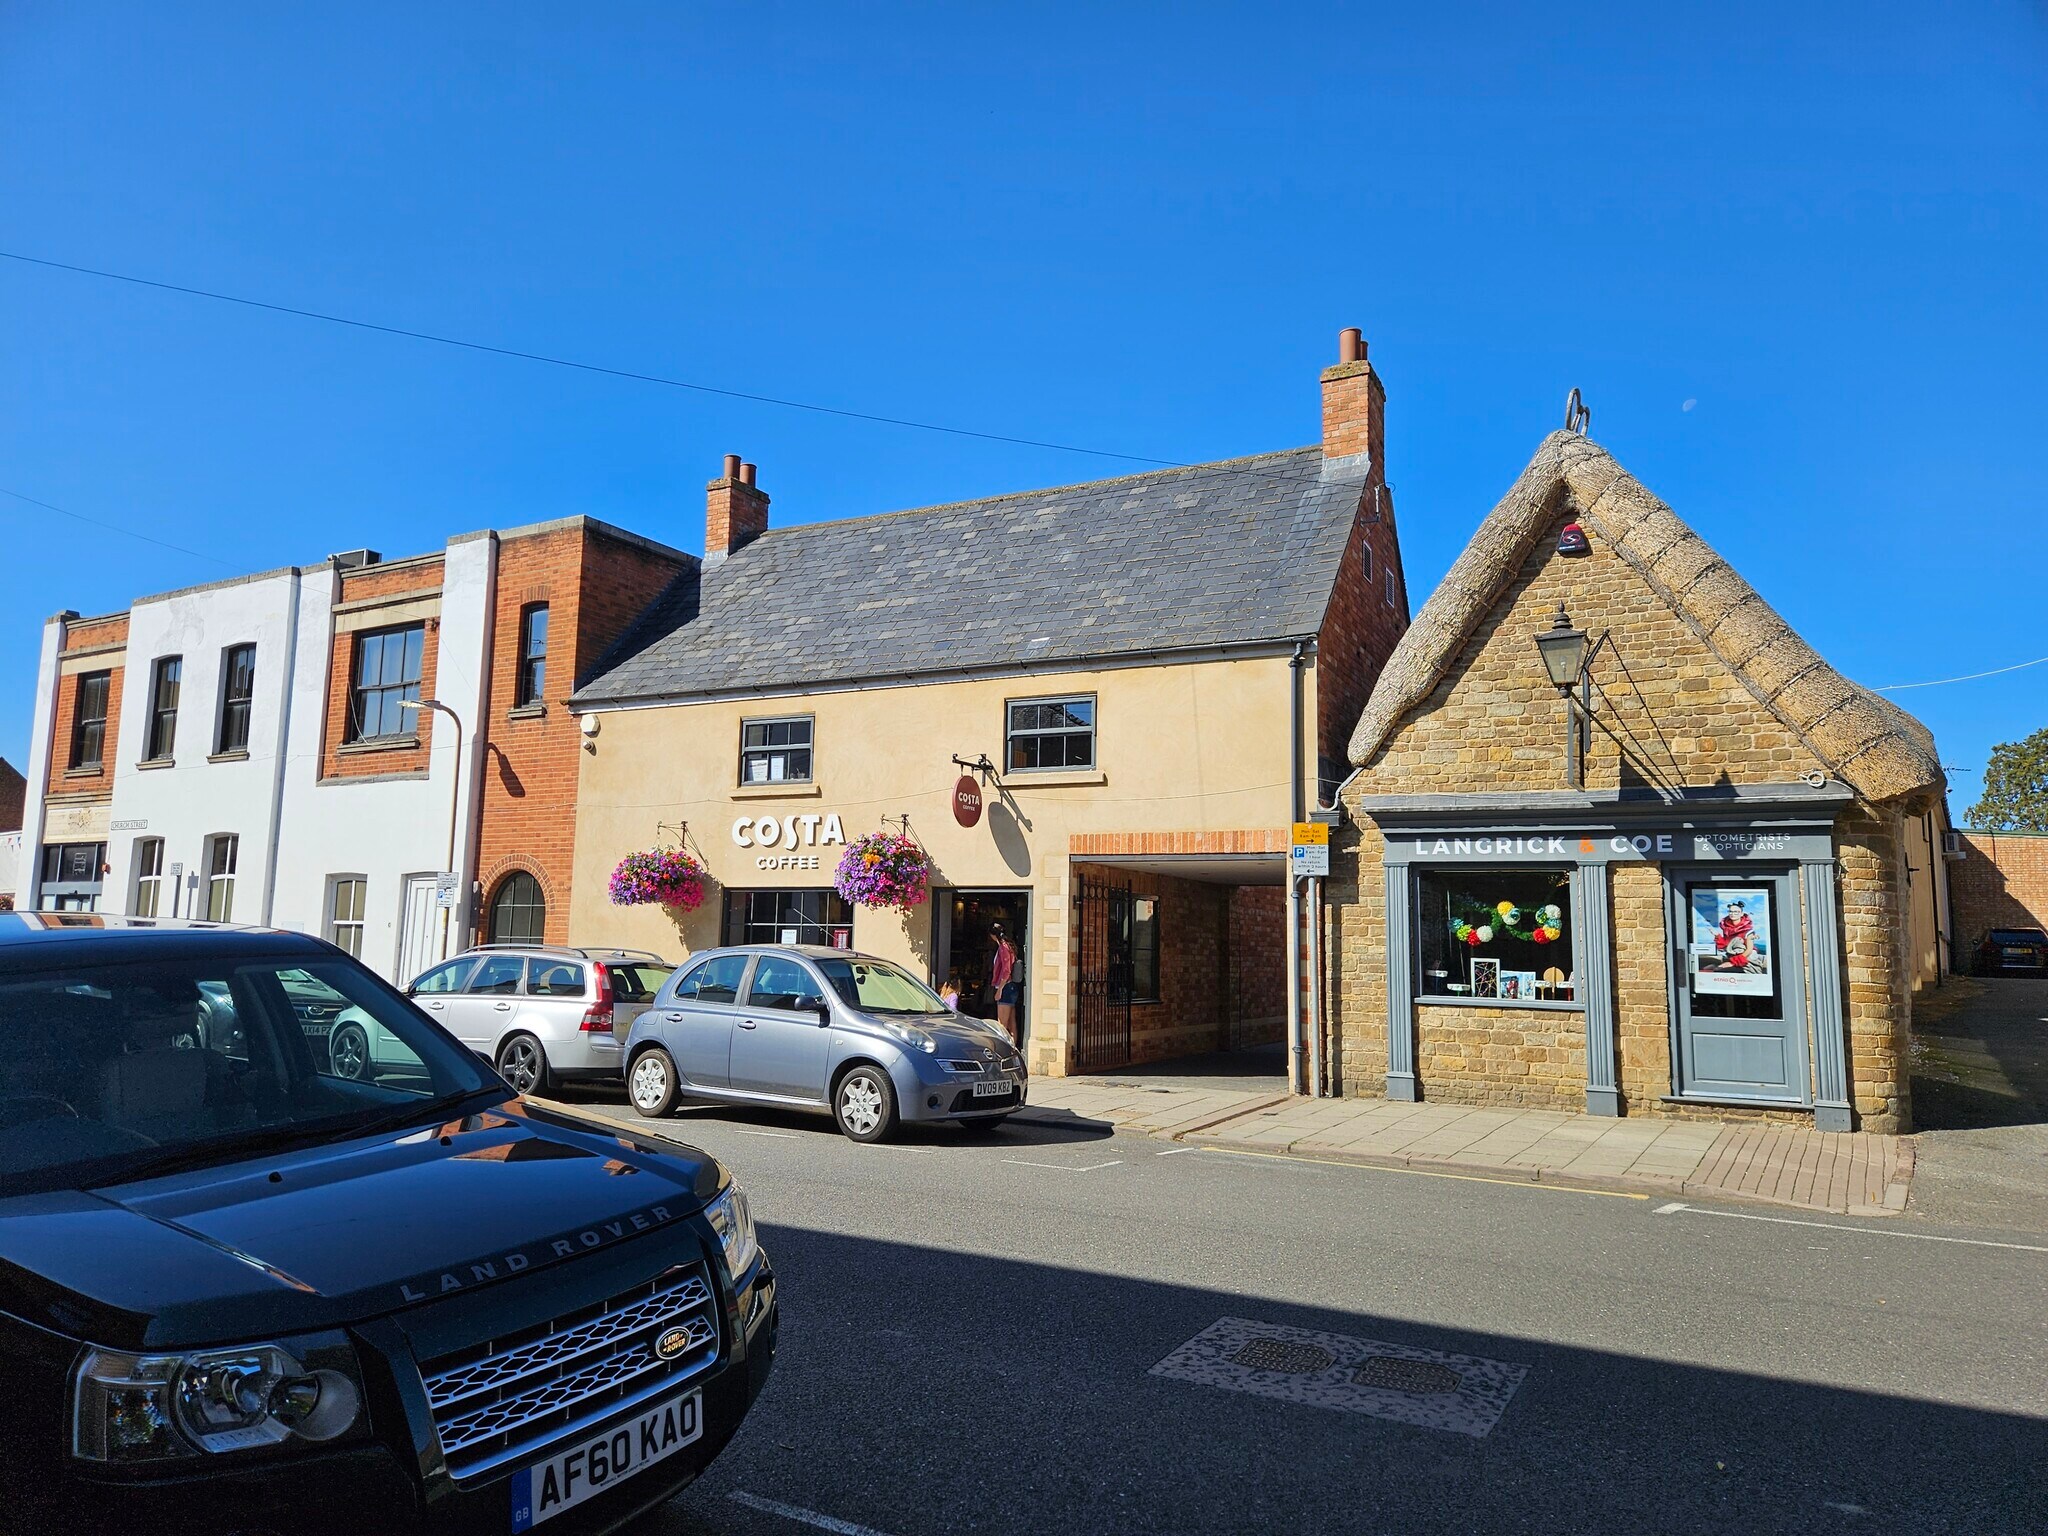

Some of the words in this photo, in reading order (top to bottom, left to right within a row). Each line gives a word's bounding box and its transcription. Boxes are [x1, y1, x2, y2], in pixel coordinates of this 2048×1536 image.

[959, 792, 980, 805] COSTA
[731, 813, 847, 851] COSTA
[1695, 833, 1791, 842] OPTOMETRISTS
[1415, 836, 1566, 855] LANGRICK
[1579, 836, 1595, 854] &
[1610, 834, 1673, 853] COE
[1702, 843, 1710, 851] &
[1715, 842, 1784, 851] OPTICIANS
[756, 857, 819, 869] COFFEE
[977, 1083, 996, 1095] DV09
[998, 1081, 1010, 1092] KBZ
[400, 1253, 529, 1302] LAND
[550, 1206, 672, 1257] ROVER
[664, 1333, 680, 1345] LAND
[667, 1338, 686, 1353] ROVER
[539, 1429, 631, 1512] AF60
[515, 1507, 530, 1522] GB
